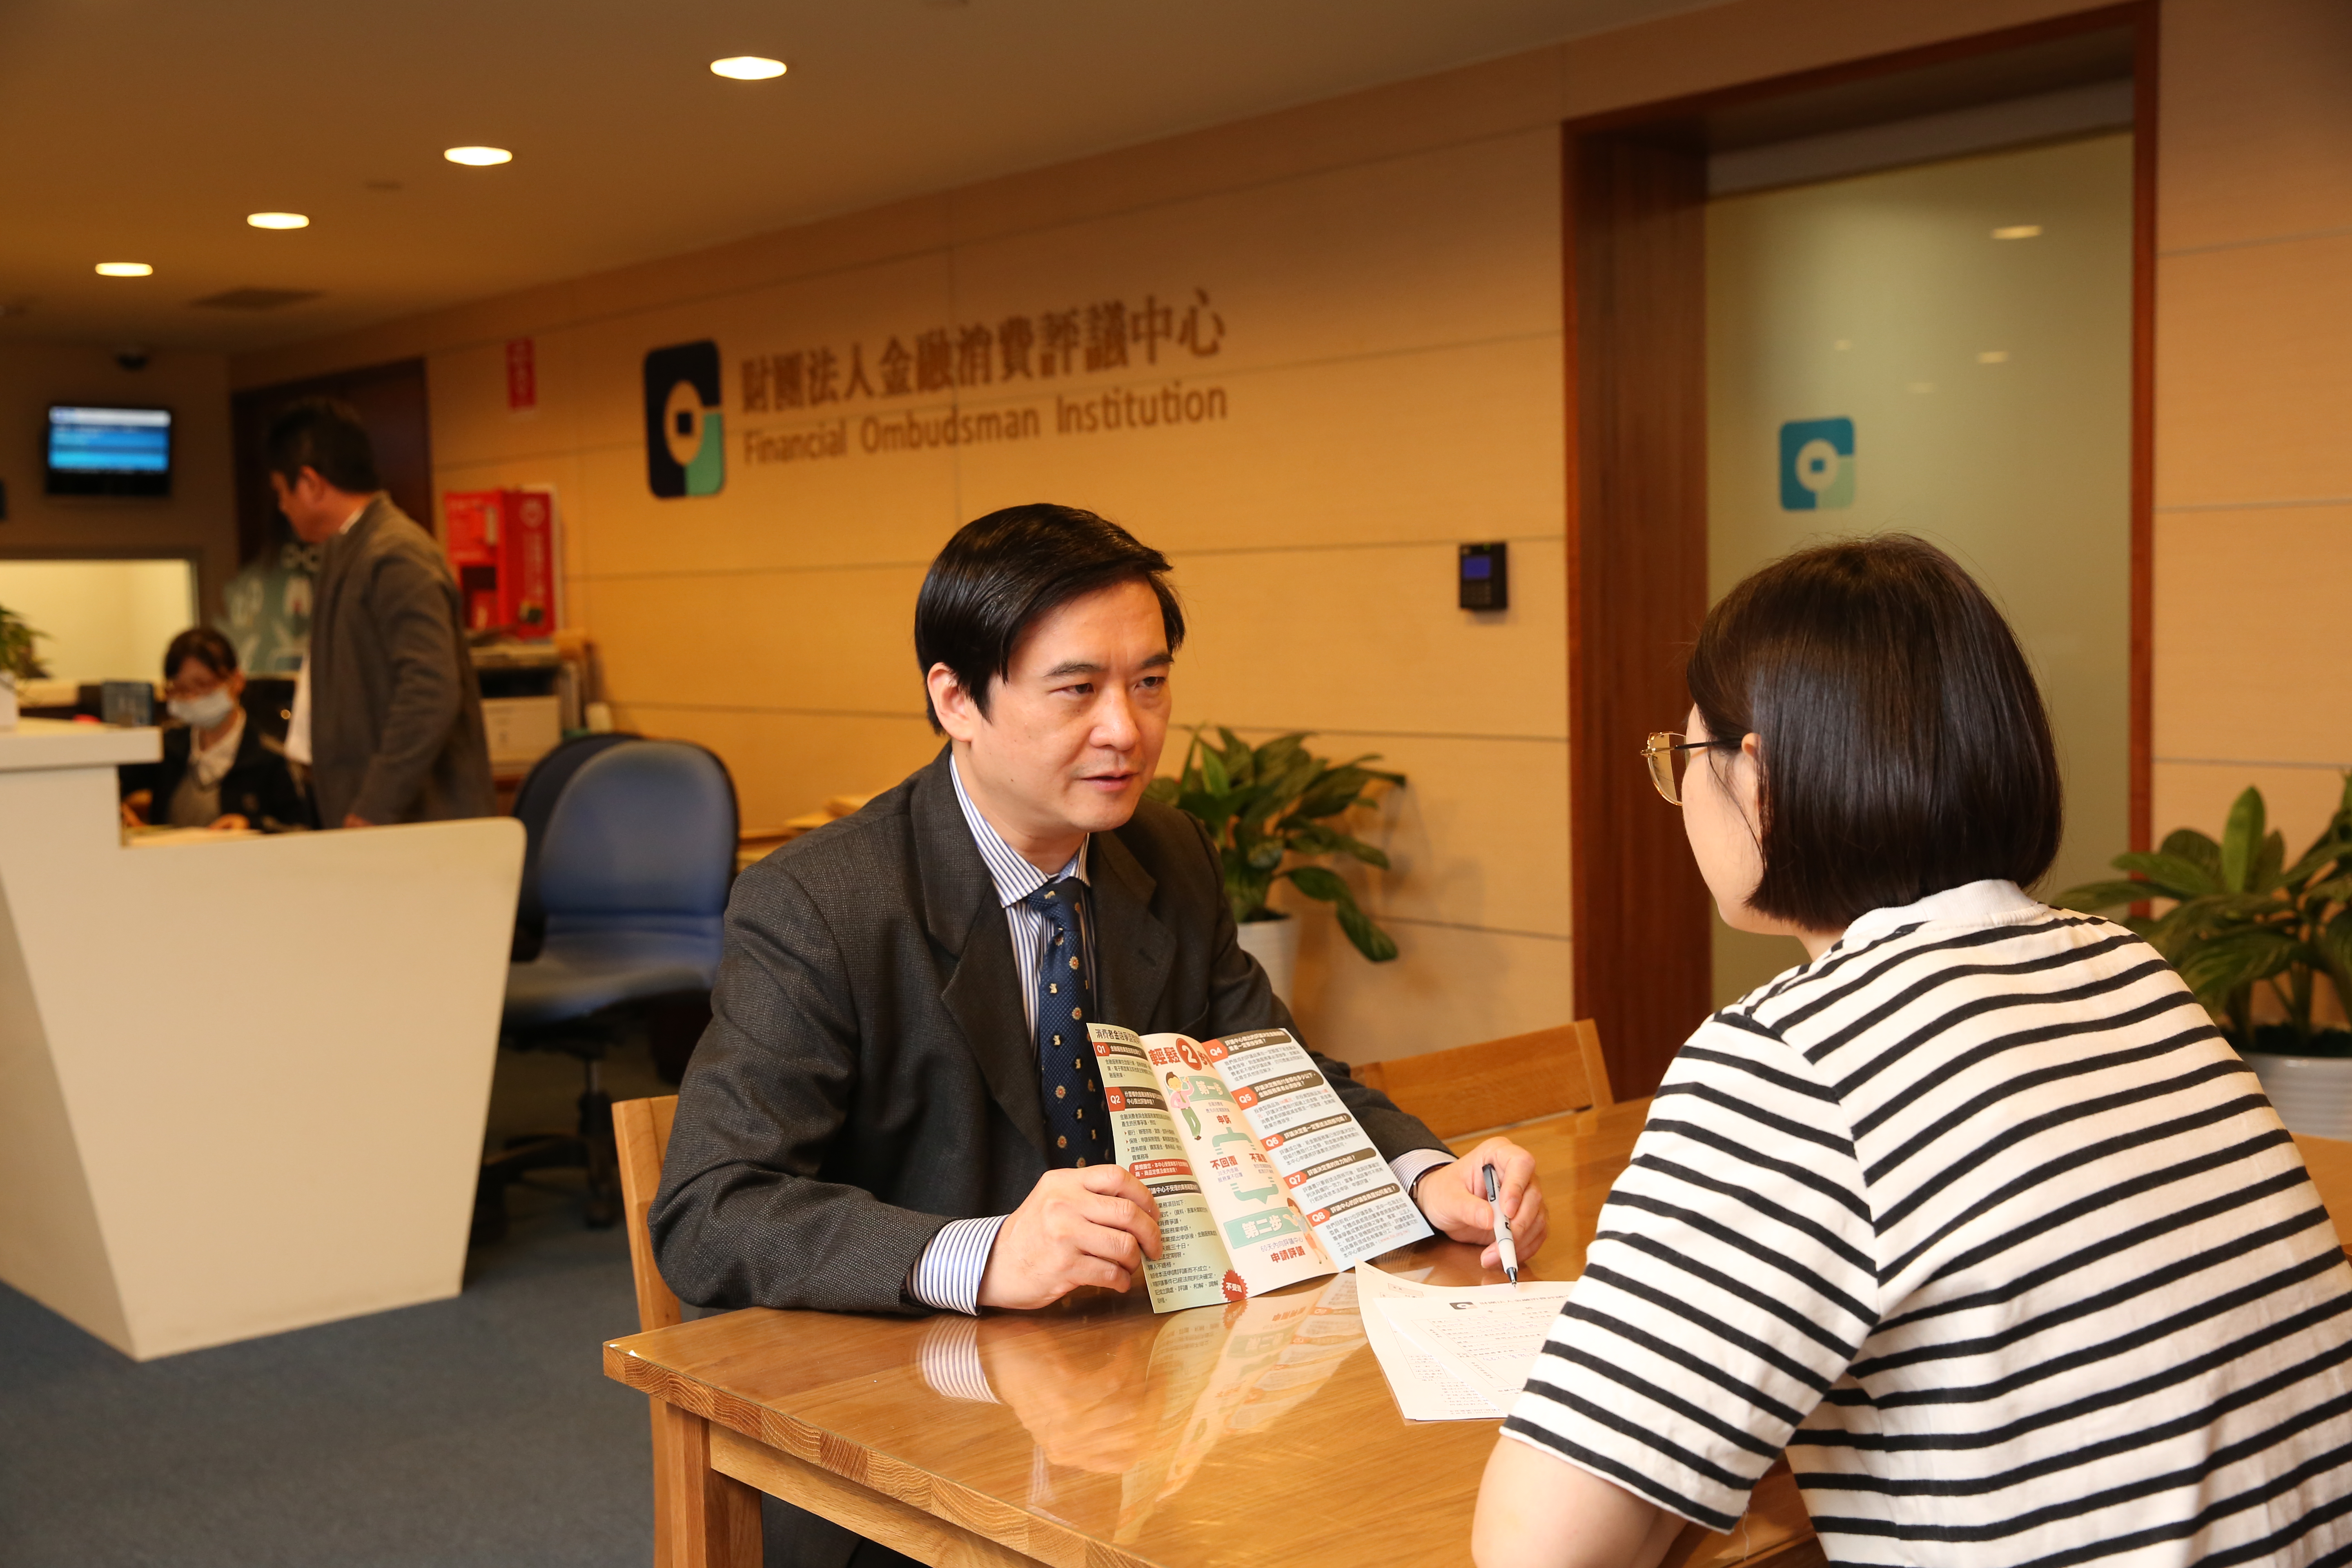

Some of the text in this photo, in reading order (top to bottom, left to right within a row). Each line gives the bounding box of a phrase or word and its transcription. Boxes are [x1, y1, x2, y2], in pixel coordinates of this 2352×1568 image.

[740, 288, 1225, 414] 財團法人金融消費評議中心
[744, 381, 1227, 466] Financial Ombudsman Institution
[1097, 1045, 1106, 1054] Q1
[1209, 1047, 1223, 1056] Q4
[1196, 1080, 1223, 1096] 第一步
[1110, 1095, 1121, 1105] Q2
[1239, 1094, 1252, 1104] Q5
[1216, 1114, 1232, 1125] 申訴
[1266, 1137, 1279, 1147] Q6
[1209, 1155, 1238, 1170] 不回覆
[1289, 1174, 1302, 1185] Q7
[1157, 1200, 1186, 1208] 業務項目如下:
[1312, 1212, 1325, 1222] Q8
[1242, 1214, 1283, 1239] 第二步
[1270, 1245, 1306, 1263] 申請評議
